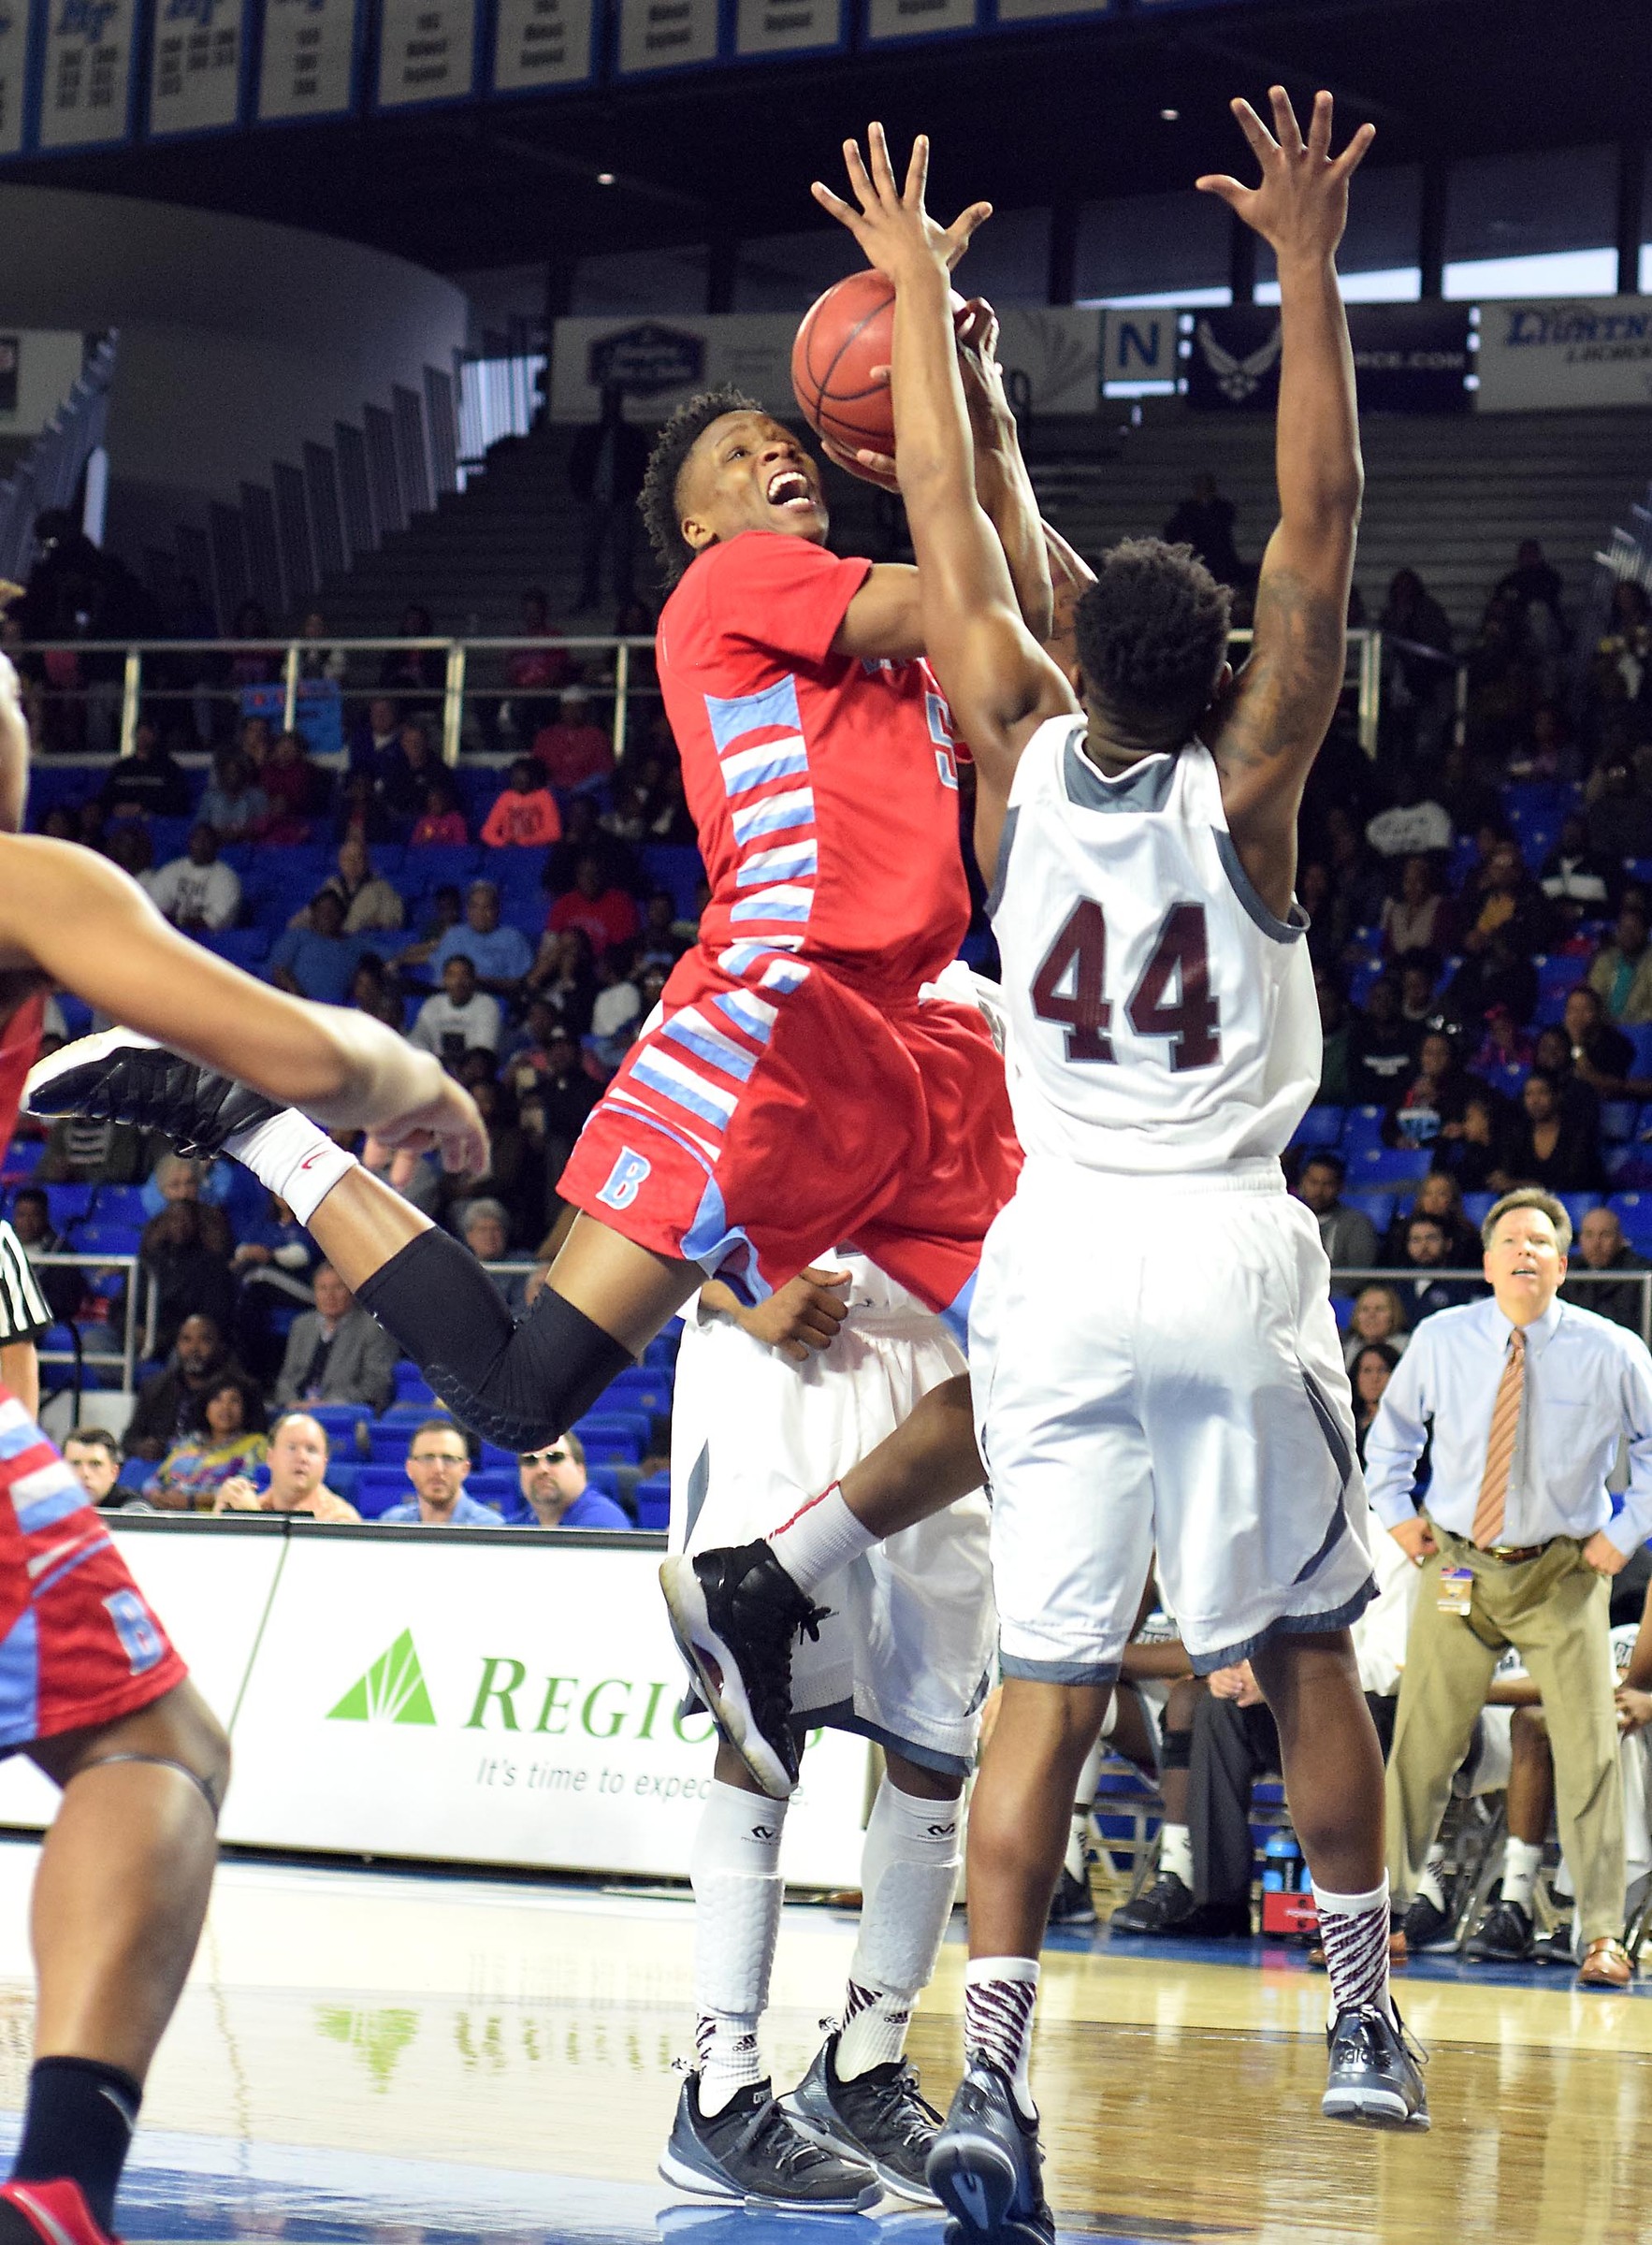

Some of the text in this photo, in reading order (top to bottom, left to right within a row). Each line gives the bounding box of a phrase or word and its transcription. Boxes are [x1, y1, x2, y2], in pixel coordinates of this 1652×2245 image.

[1029, 893, 1224, 1074] 44
[595, 1145, 652, 1210] B
[100, 1588, 165, 1677] B
[460, 1657, 824, 1750] REGIO
[475, 1758, 715, 1804] It's time to expec
